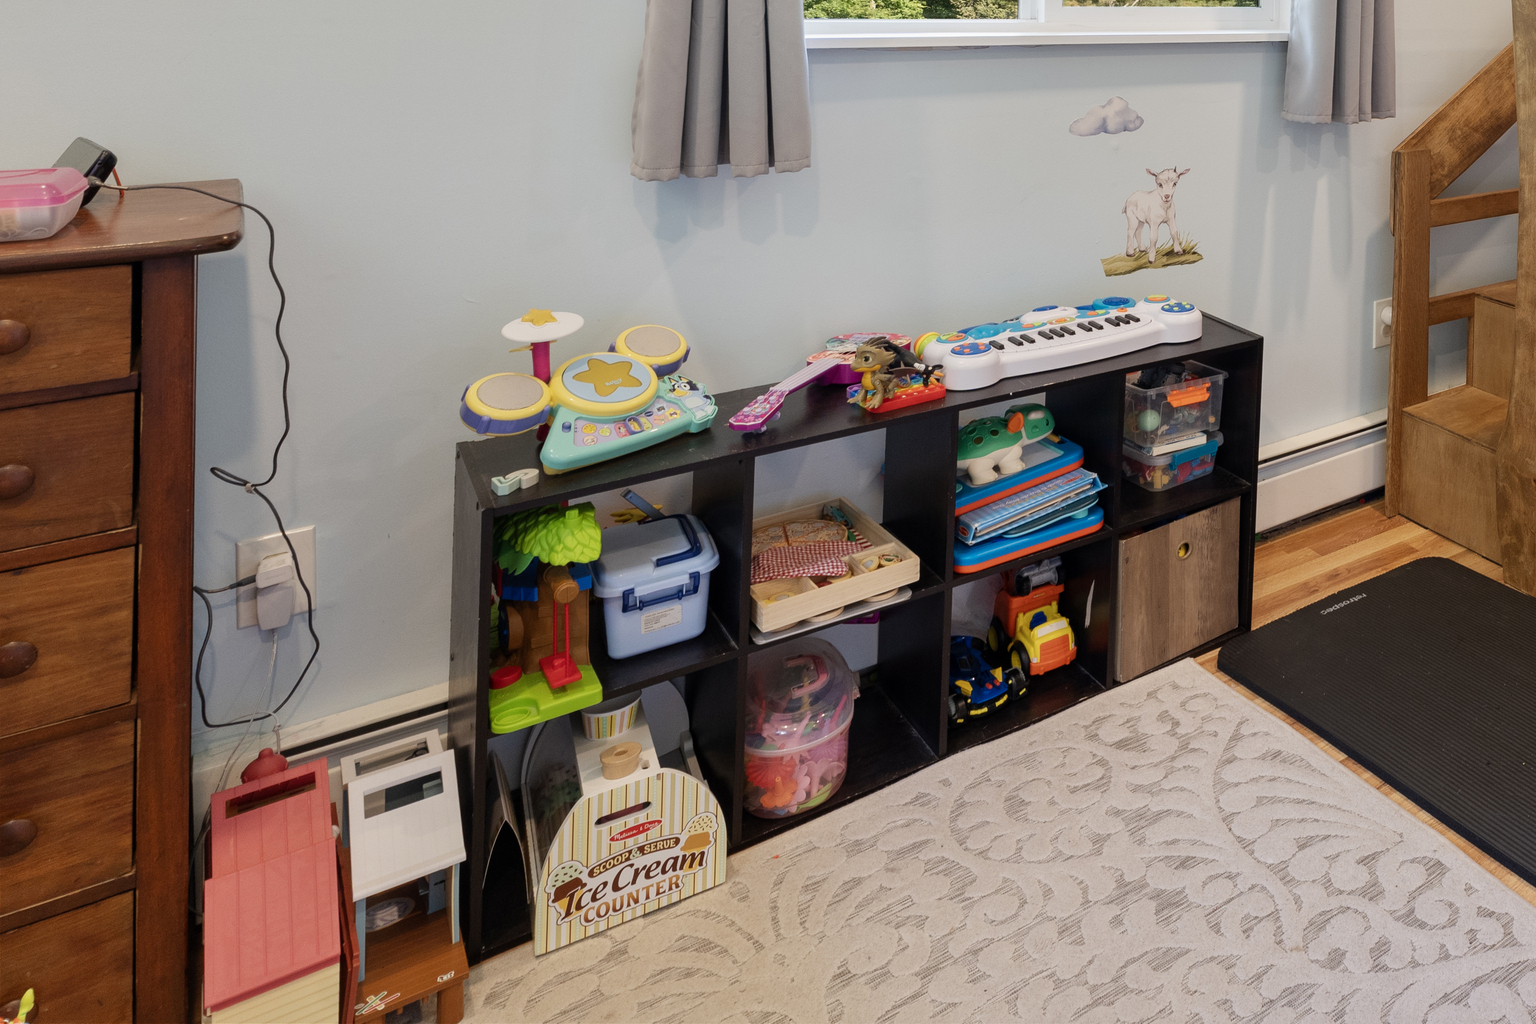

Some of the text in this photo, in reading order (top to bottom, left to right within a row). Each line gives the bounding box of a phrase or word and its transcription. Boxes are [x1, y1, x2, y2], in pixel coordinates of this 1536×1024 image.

[1320, 593, 1367, 615] retrospec
[593, 838, 676, 877] SCOOP & SERVE
[560, 850, 705, 922] Ice Cream
[583, 874, 681, 924] COUNTER
